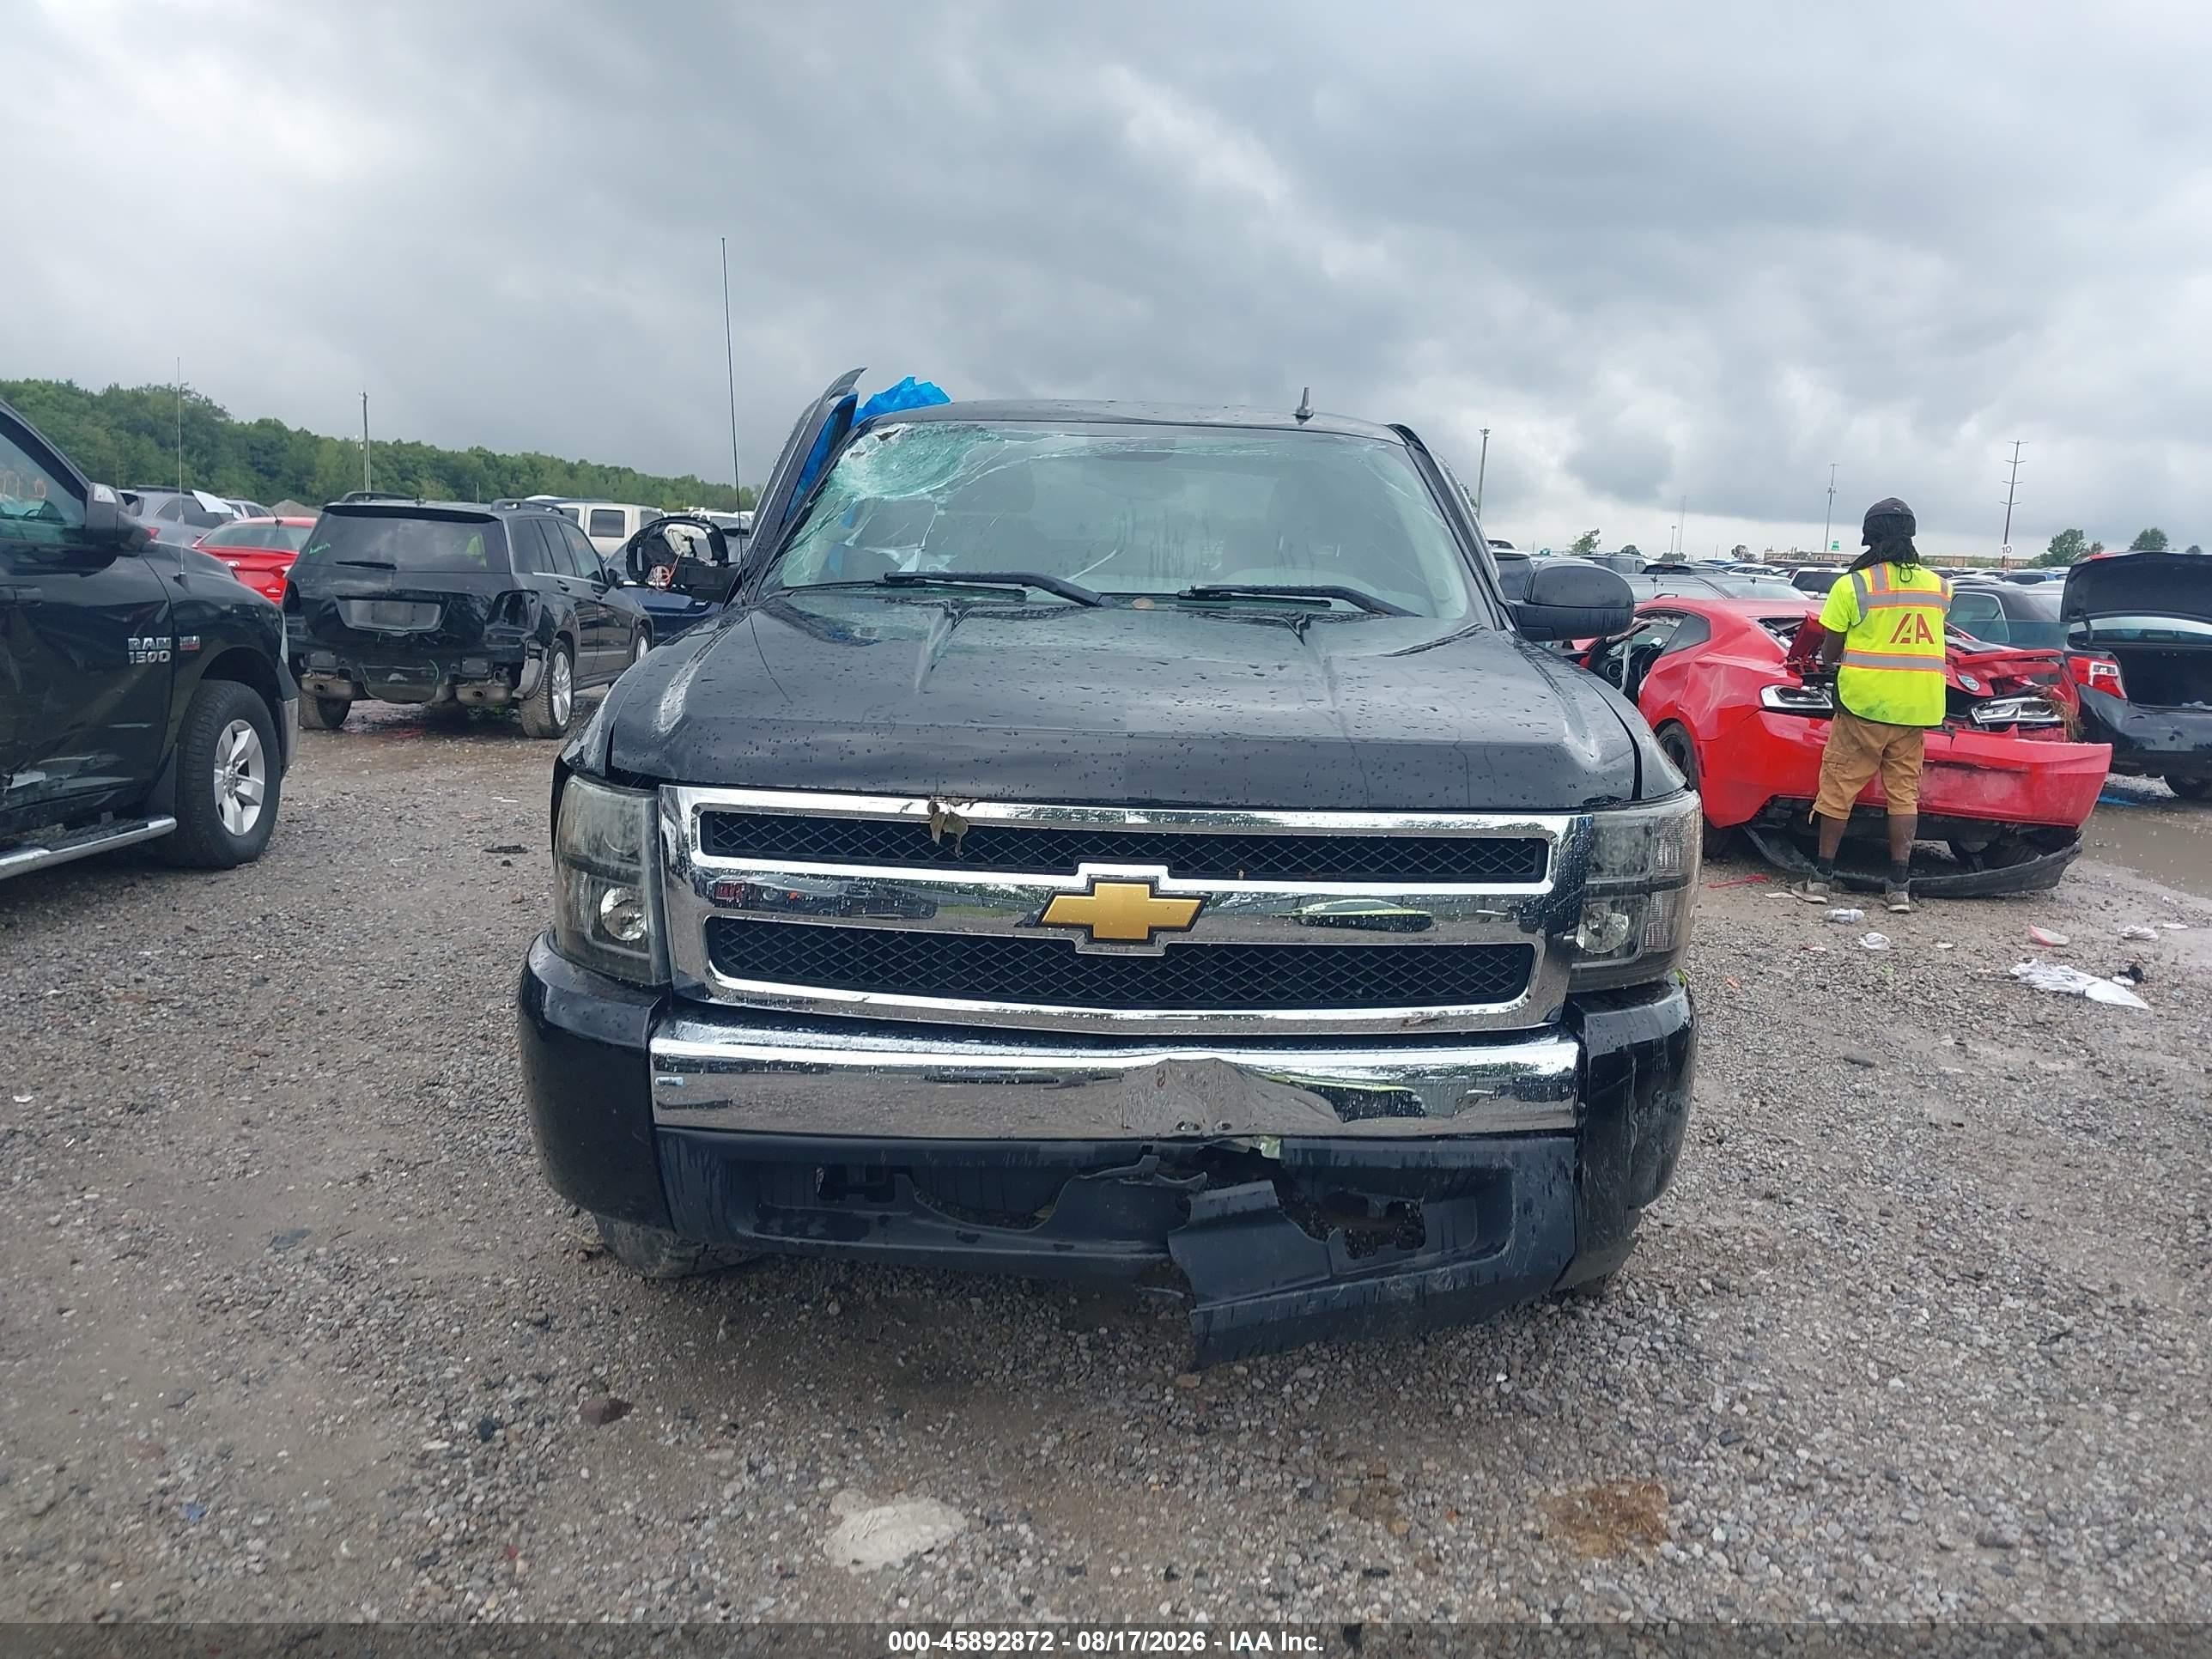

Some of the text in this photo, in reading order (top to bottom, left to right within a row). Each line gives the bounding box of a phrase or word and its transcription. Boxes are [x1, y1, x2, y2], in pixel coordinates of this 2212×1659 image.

[2001, 545, 2012, 554] 10
[127, 637, 172, 650] RAM
[128, 650, 171, 665] 1500
